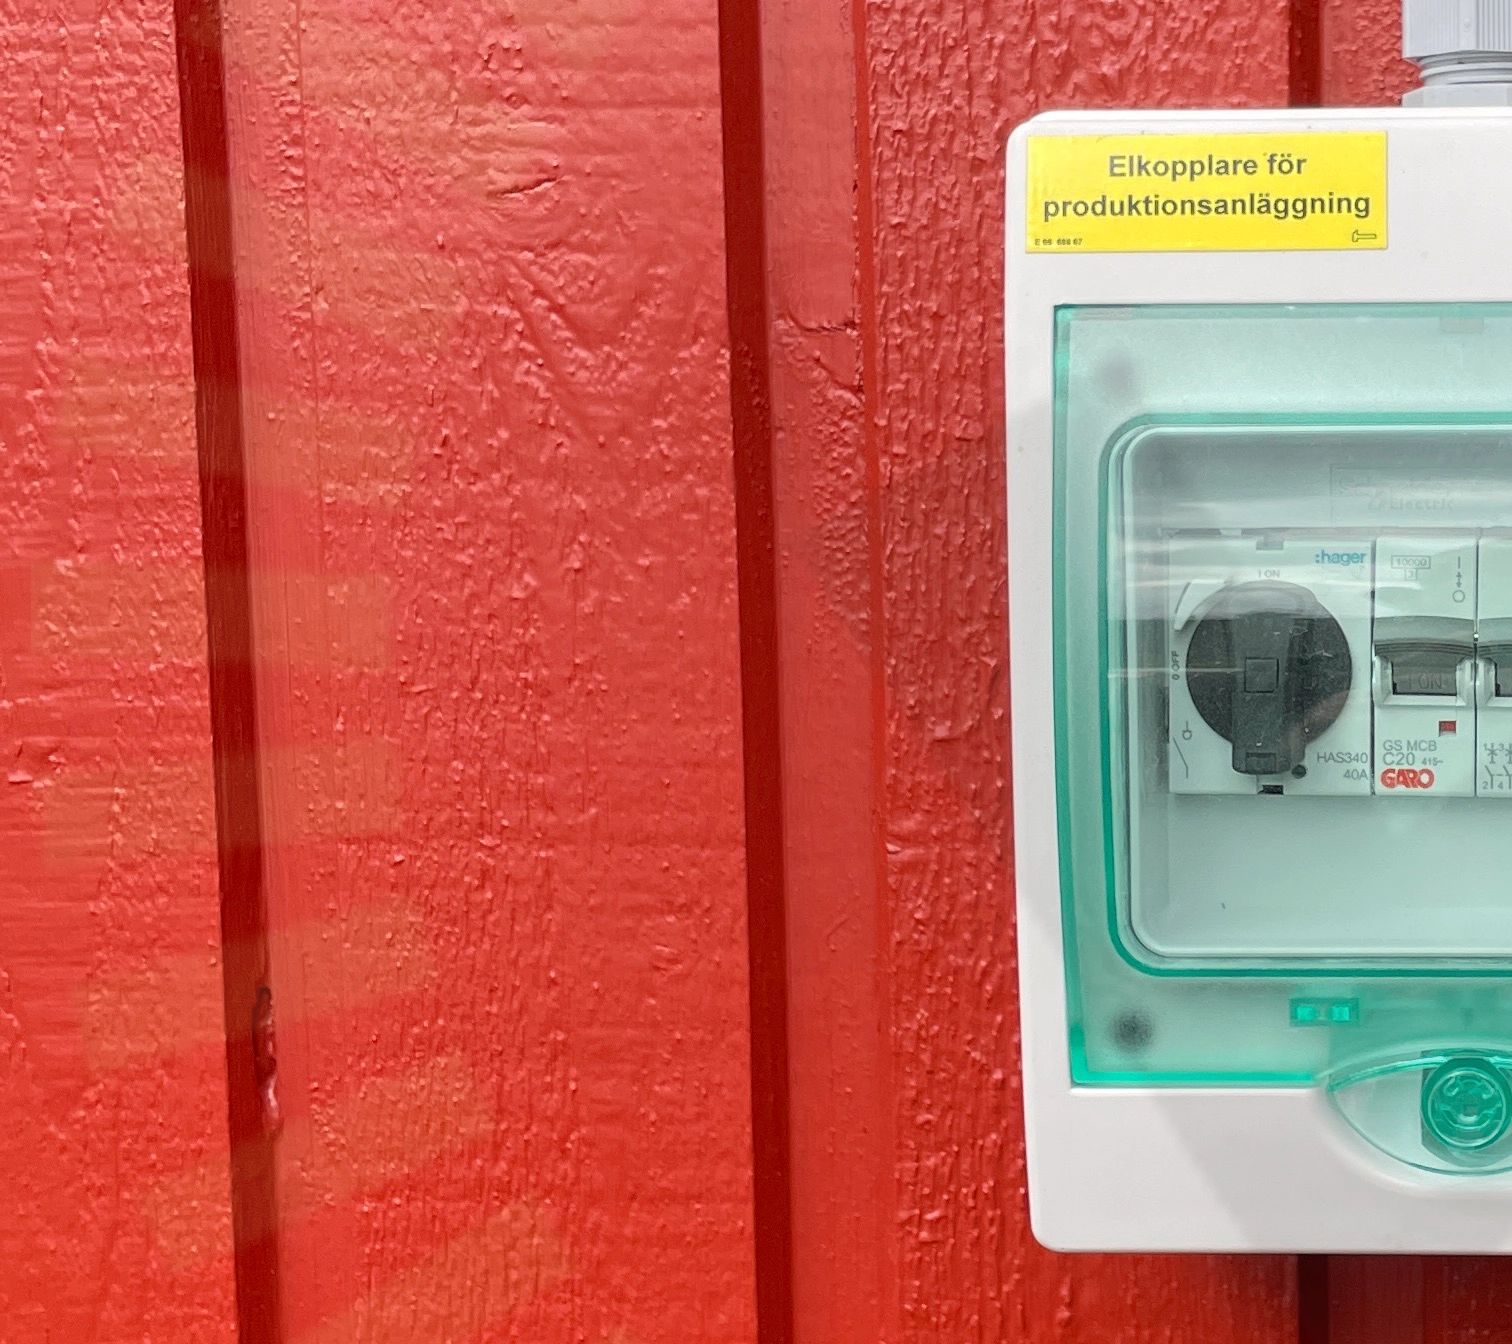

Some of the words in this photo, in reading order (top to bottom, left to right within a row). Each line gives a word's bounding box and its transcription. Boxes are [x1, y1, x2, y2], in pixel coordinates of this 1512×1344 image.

[1108, 155, 1258, 181] Elkopplare
[1266, 153, 1307, 175] för
[1043, 192, 1371, 223] produktionsanläggning
[1264, 569, 1280, 578] ON
[1171, 650, 1180, 672] OFF
[1382, 739, 1403, 752] GS
[1406, 739, 1437, 752] MCB
[1316, 751, 1369, 764] HAS340
[1382, 752, 1416, 766] C20
[1343, 768, 1369, 780] 40A
[1380, 768, 1435, 789] GARO
